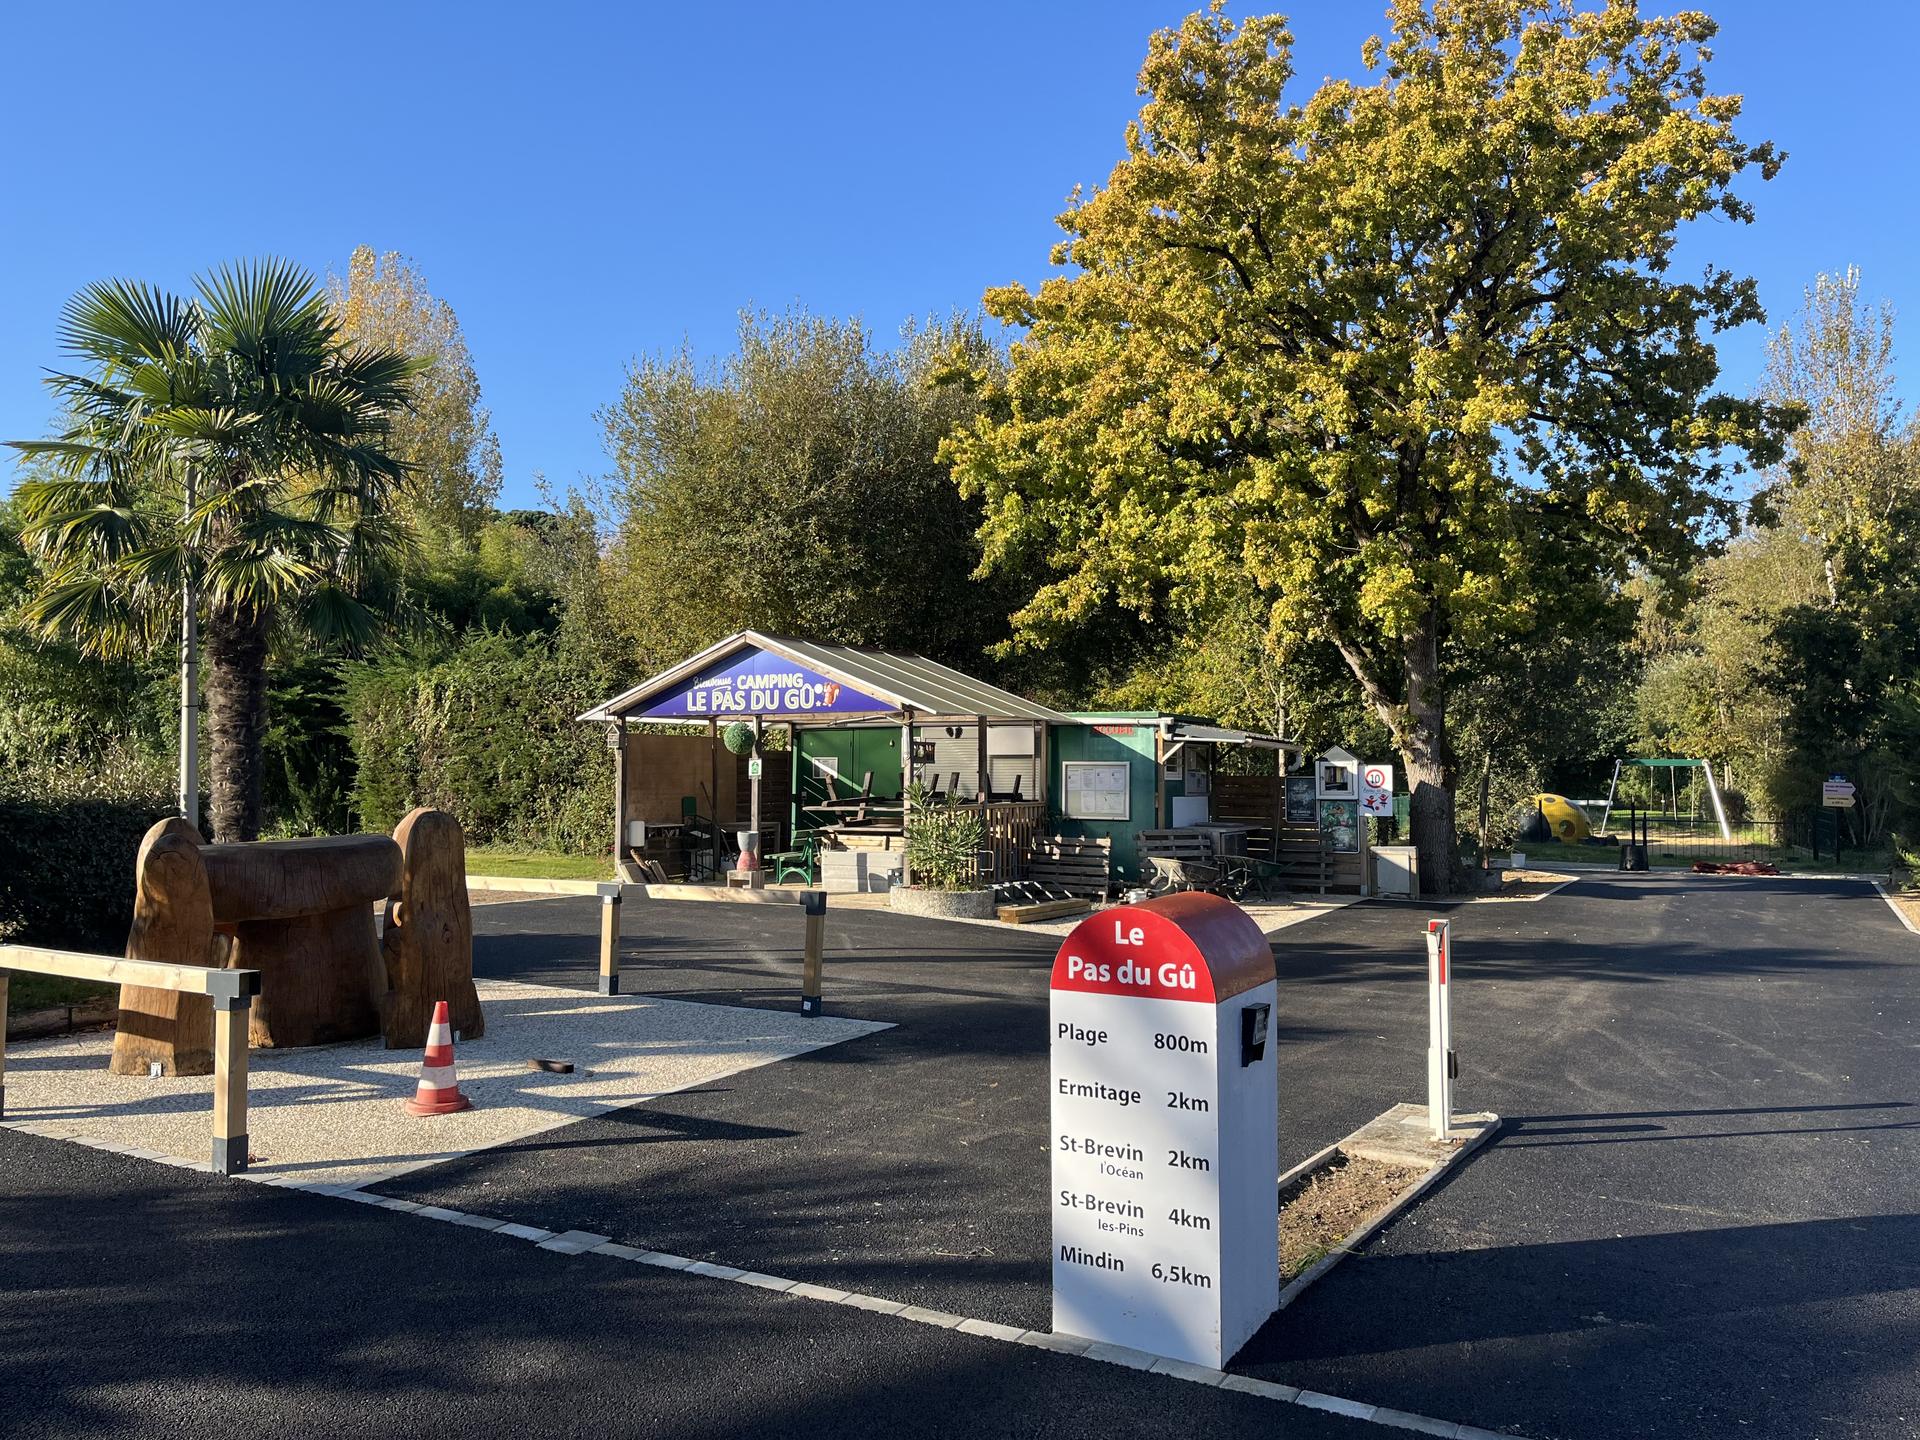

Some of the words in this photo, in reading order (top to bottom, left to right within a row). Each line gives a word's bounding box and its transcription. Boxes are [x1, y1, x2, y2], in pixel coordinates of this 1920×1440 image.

[693, 676, 732, 690] Bienvenue
[737, 673, 803, 689] CAMPING
[687, 692, 707, 711] LE
[712, 690, 746, 711] PAS
[751, 690, 780, 710] DU
[784, 683, 814, 709] GÛ
[1370, 774, 1381, 784] 10
[1114, 921, 1144, 946] Le
[1067, 955, 1110, 982] Pas
[1116, 960, 1151, 986] du
[1158, 963, 1196, 990] Gû
[1058, 1022, 1108, 1046] Plage
[1154, 1033, 1208, 1054] 800m
[1058, 1078, 1142, 1106] Ermitage
[1167, 1092, 1209, 1114] 2km
[1060, 1135, 1144, 1162] St-Brevin
[1168, 1150, 1210, 1173] 2km
[1060, 1190, 1144, 1219] St-Brevin
[1168, 1207, 1211, 1231] 4km
[1098, 1217, 1144, 1238] les-Pins
[1060, 1245, 1125, 1272] Mindin
[1151, 1263, 1212, 1289] 6,5km
